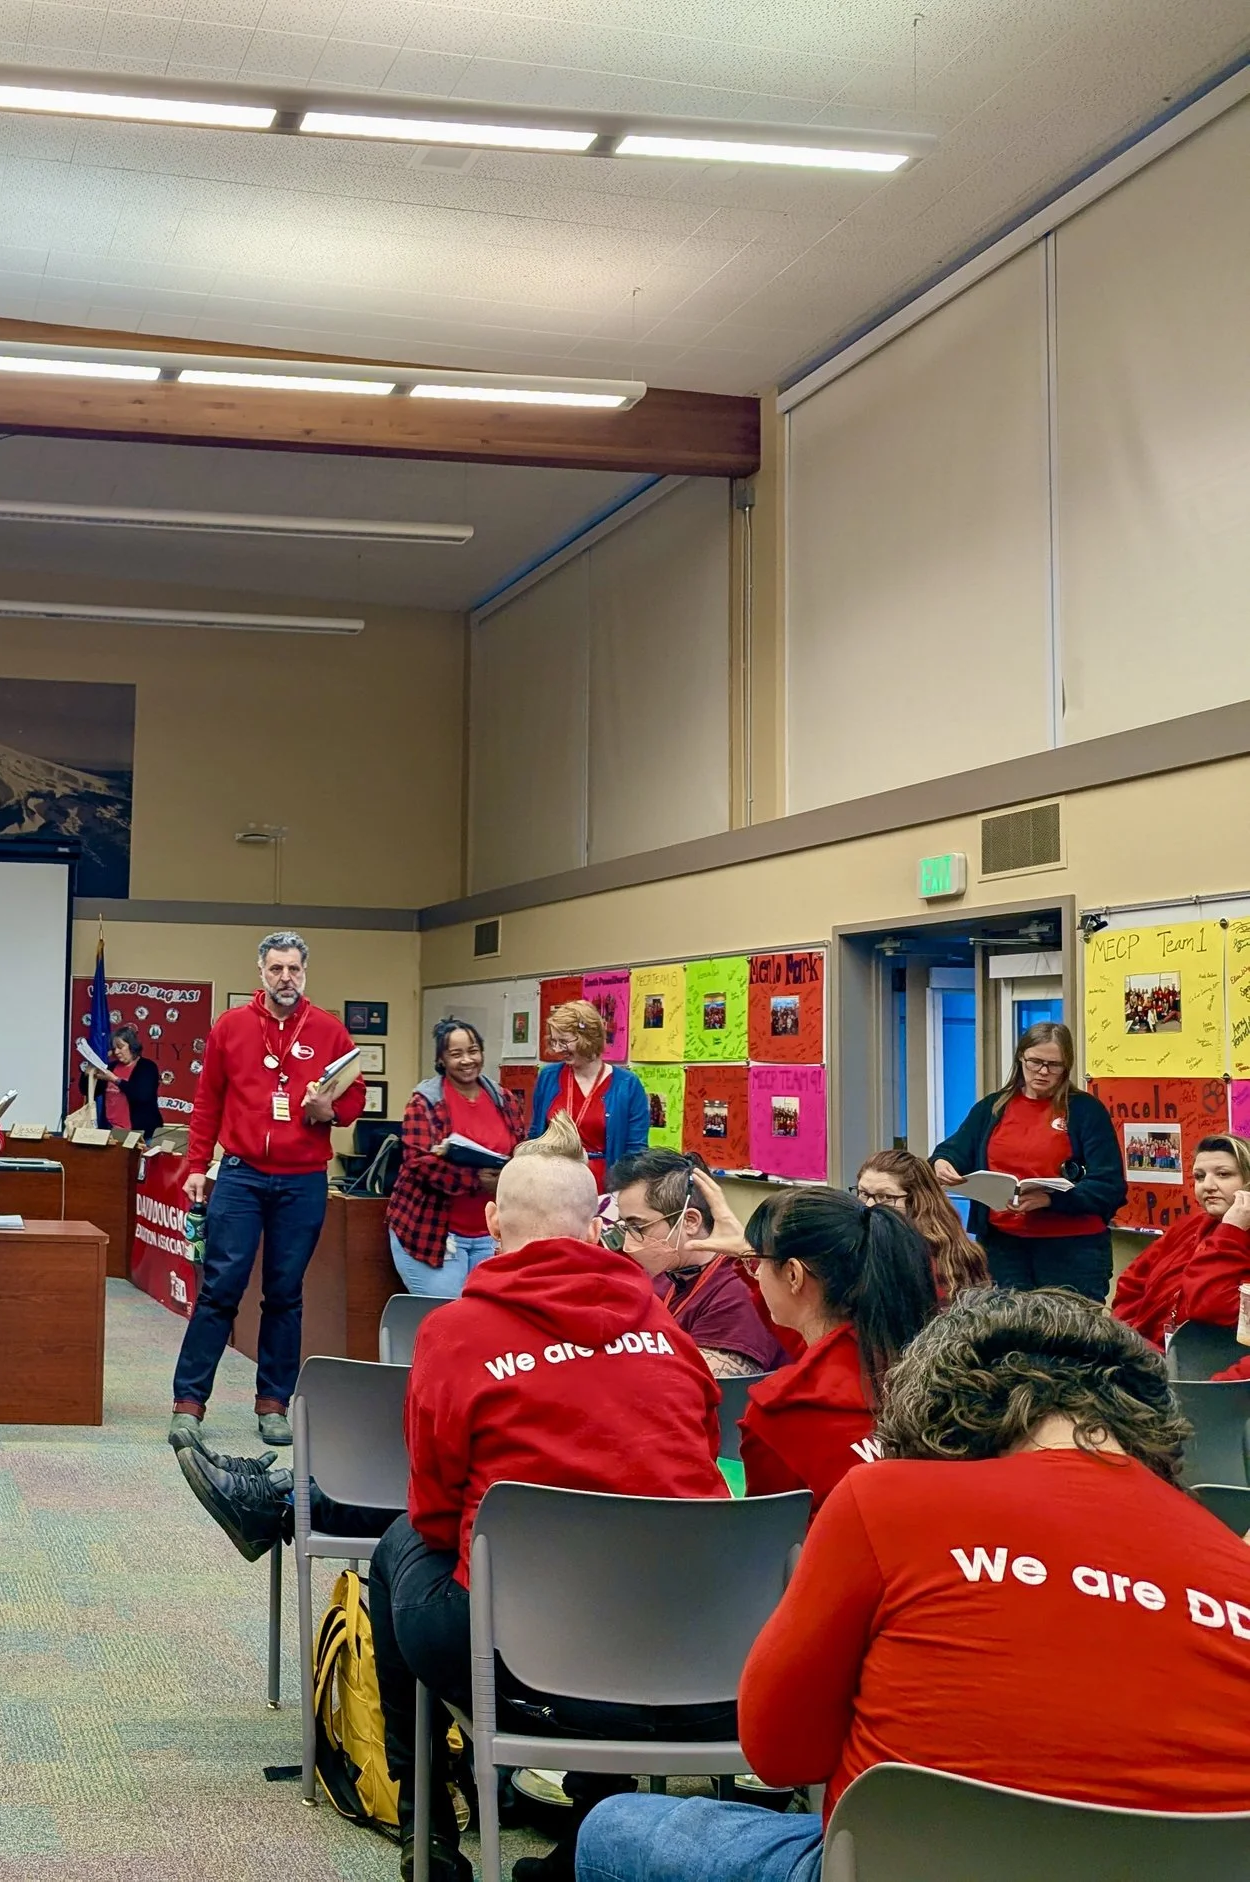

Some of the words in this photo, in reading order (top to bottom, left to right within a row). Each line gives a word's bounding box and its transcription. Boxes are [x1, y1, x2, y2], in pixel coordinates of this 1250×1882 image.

[921, 856, 951, 894] EXIT
[1092, 934, 1140, 964] MECP
[785, 952, 820, 985] Park
[110, 982, 138, 994] ARE
[138, 984, 200, 1002] DOUGLAS!
[752, 1070, 777, 1091] MECP
[778, 1070, 809, 1091] TEAM
[484, 1352, 536, 1381] We
[544, 1342, 595, 1364] are
[604, 1331, 675, 1356] DDEA
[850, 1438, 884, 1463] W
[950, 1547, 1048, 1585] We
[1072, 1565, 1166, 1611] are
